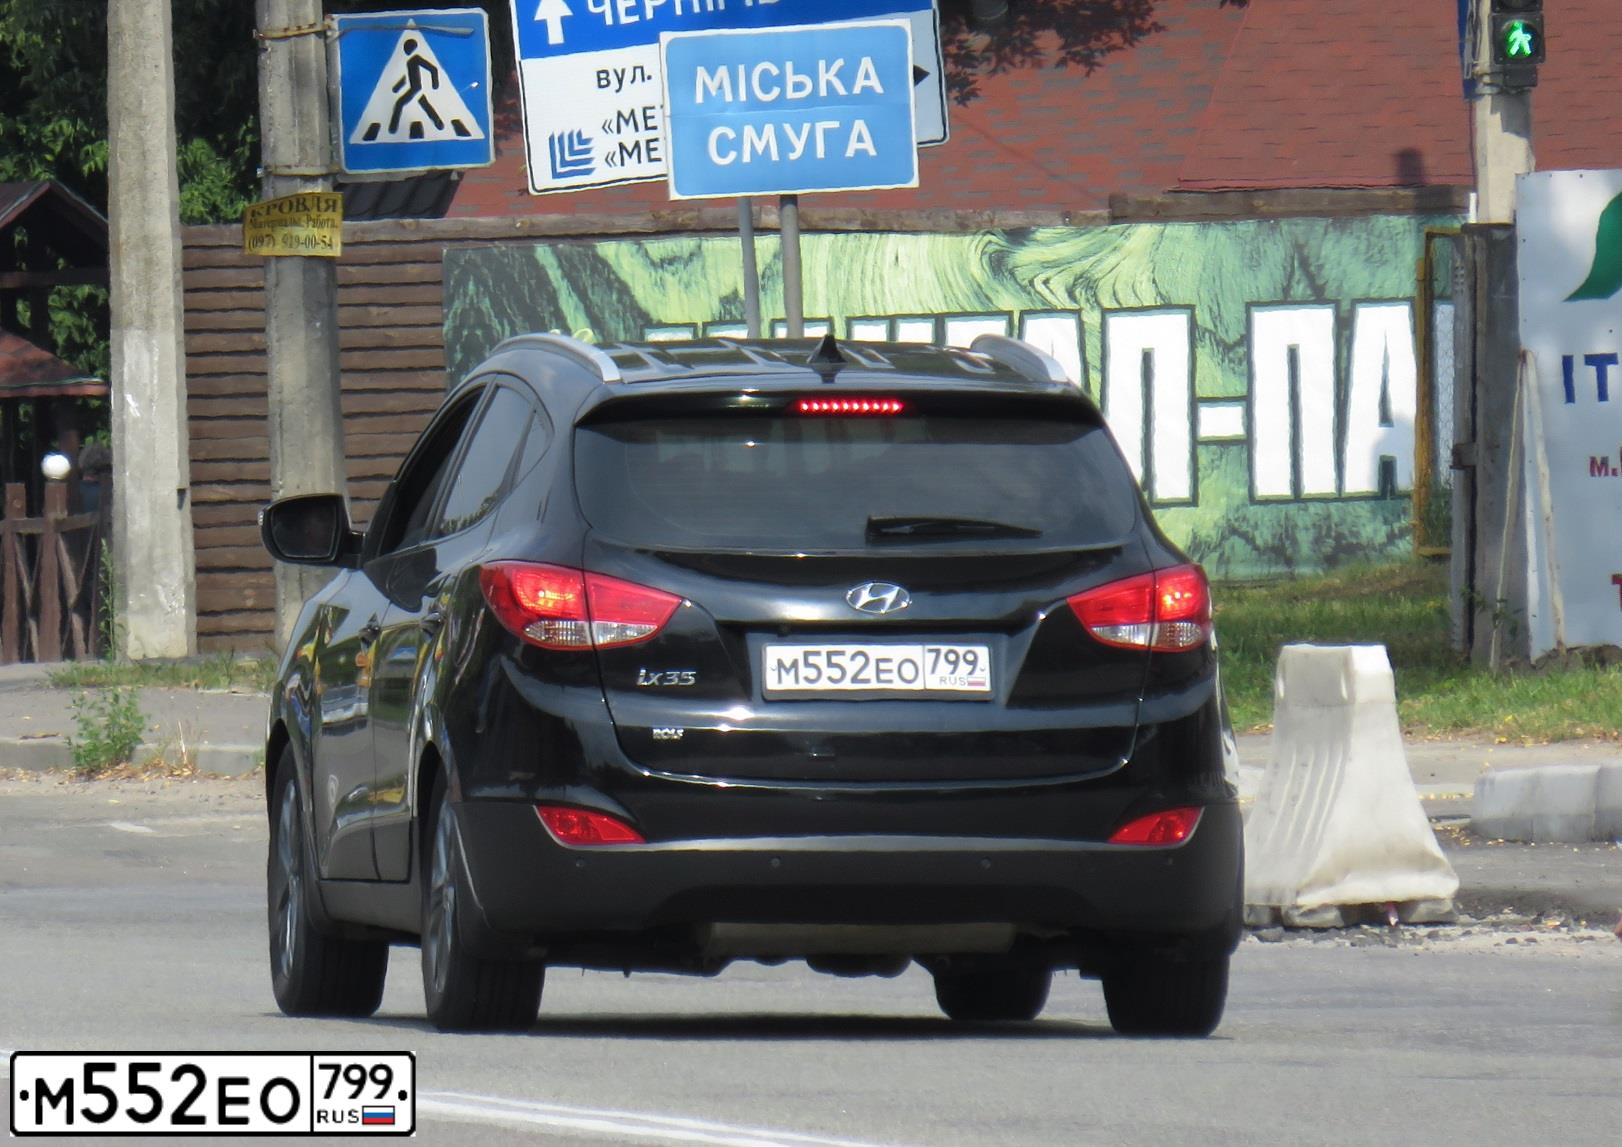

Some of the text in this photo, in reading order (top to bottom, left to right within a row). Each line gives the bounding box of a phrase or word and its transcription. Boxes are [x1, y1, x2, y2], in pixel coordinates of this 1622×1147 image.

[596, 65, 652, 93] вул.
[695, 57, 885, 104] МІСЬКА
[602, 106, 664, 135] «МЕ
[605, 137, 666, 168] «МЕ
[708, 120, 878, 167] СМУГА
[251, 197, 338, 217] КРОВЛЯ
[636, 669, 697, 686] ix35
[777, 648, 979, 686] М552ЕО 799
[939, 676, 966, 687] RUS
